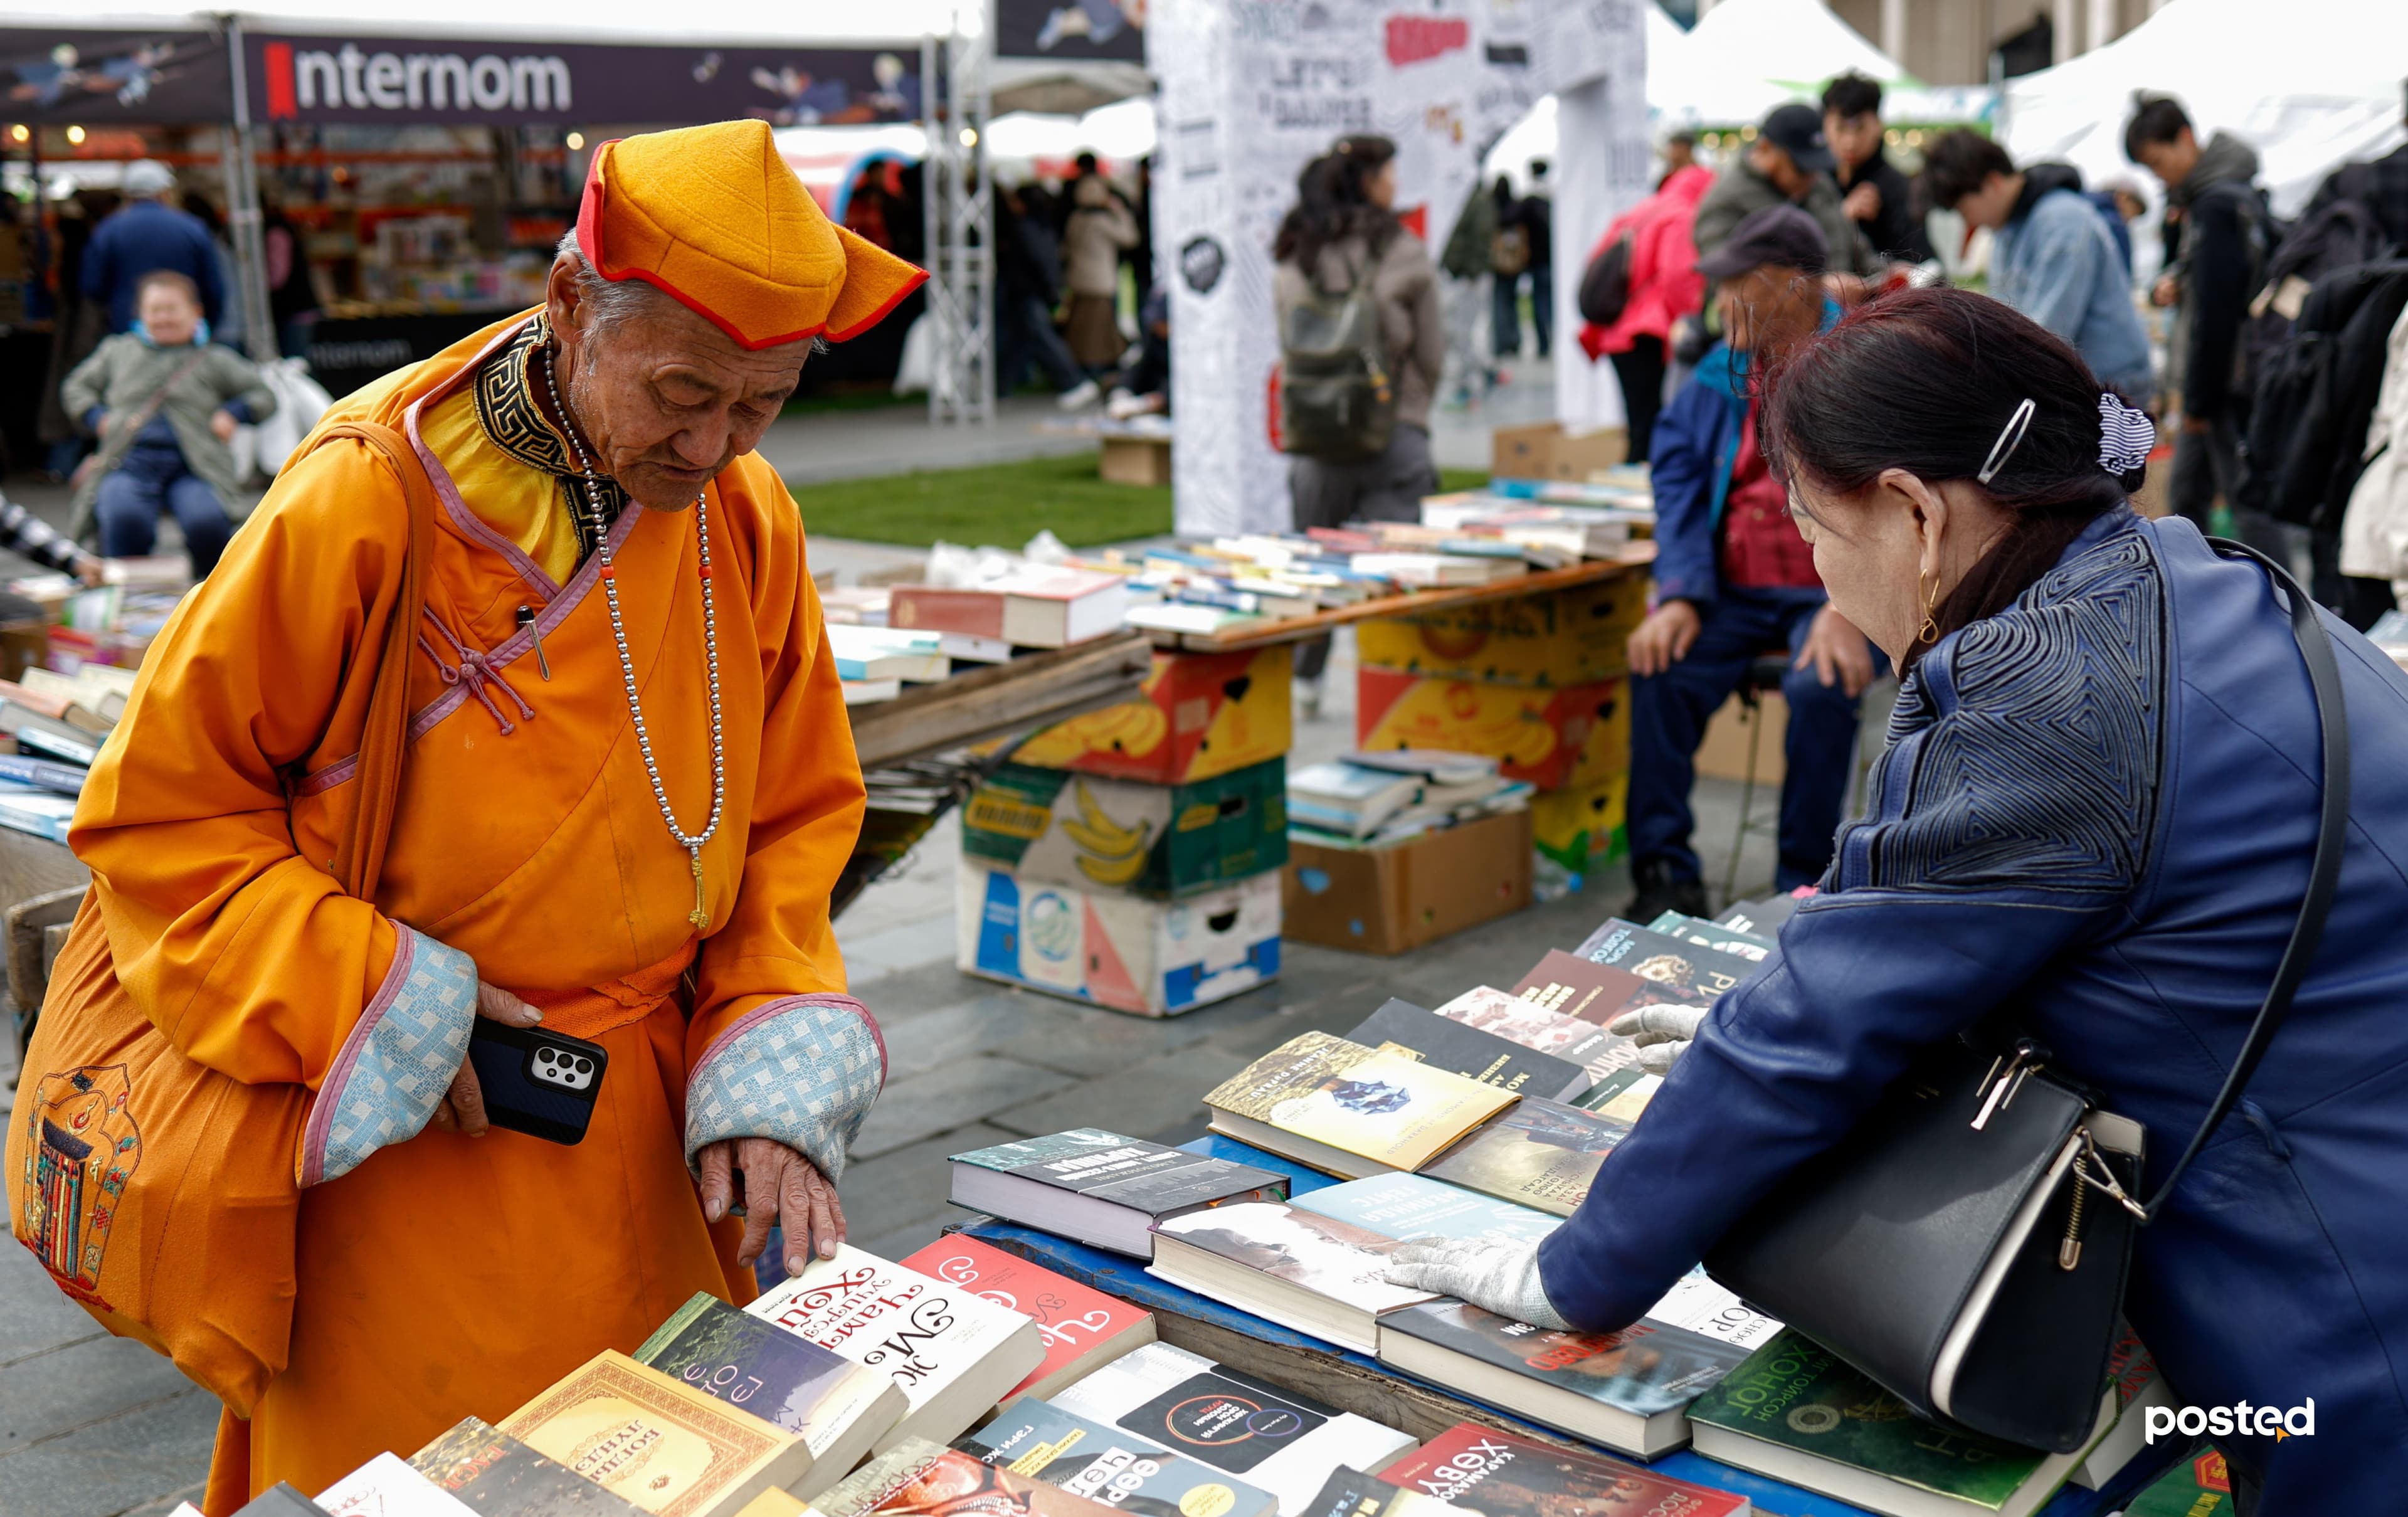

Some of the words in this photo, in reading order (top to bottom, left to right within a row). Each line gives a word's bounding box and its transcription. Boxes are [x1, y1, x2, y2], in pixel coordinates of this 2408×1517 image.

[264, 41, 572, 119] Internom
[1288, 1047, 1331, 1071] JEANNE
[998, 1424, 1036, 1449] ГЭРИ
[1433, 1451, 1517, 1503] КАРАМАЗО
